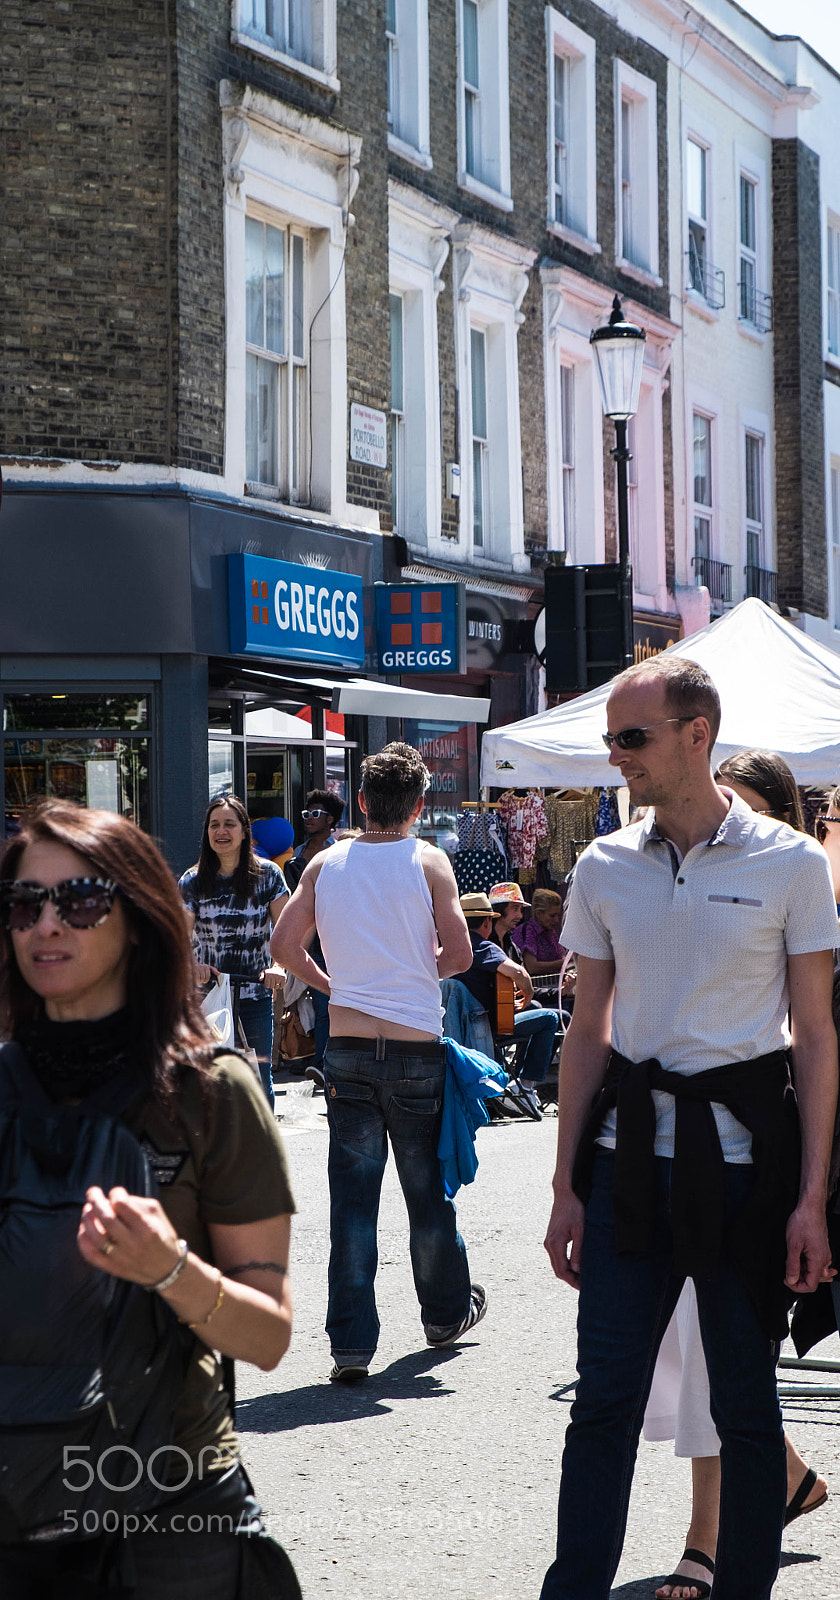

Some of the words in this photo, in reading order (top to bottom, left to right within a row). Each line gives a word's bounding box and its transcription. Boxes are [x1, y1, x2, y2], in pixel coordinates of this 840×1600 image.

[353, 429, 385, 449] PORTOBELLO
[274, 579, 360, 641] GREGGS
[468, 620, 502, 641] WINTERS
[382, 650, 452, 667] GREGGS
[418, 737, 460, 760] ARTISANAL
[429, 772, 457, 793] ROGEN
